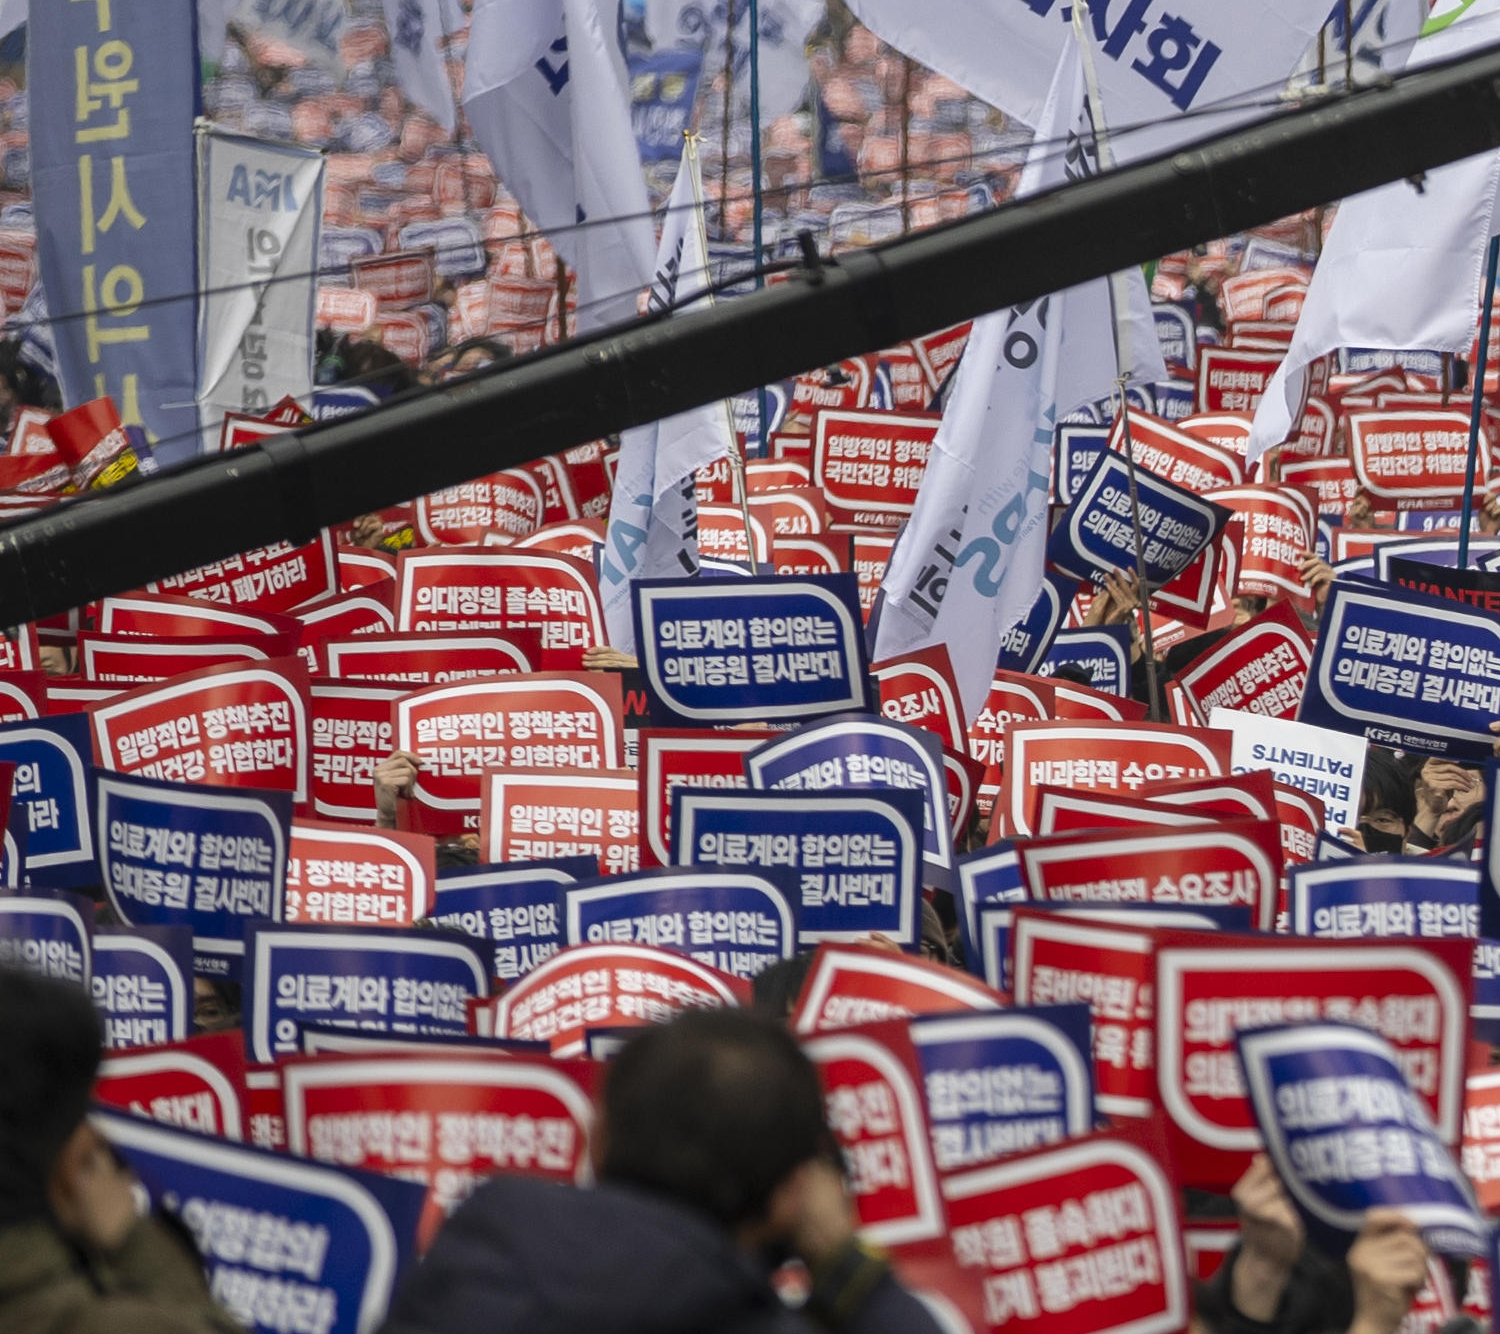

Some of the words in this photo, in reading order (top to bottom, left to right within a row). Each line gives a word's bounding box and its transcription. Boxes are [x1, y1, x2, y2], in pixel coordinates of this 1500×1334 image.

[828, 434, 890, 461] 일방적인
[826, 461, 888, 487] 국민건강
[233, 560, 308, 601] 폐기하라
[414, 585, 498, 616] 의대정원
[504, 584, 586, 615] 졸속확대
[660, 618, 746, 651] 의료계와
[749, 616, 837, 647] 합의없는
[1343, 625, 1426, 662] 의료계와
[664, 654, 749, 685] 의대증원
[753, 650, 842, 682] 결사반대
[1335, 659, 1420, 697] 의대증원
[1423, 676, 1500, 715] 결사반대
[116, 713, 202, 766] 일방적인
[202, 698, 293, 745] 정책추진
[414, 713, 498, 743] 일방적인
[508, 711, 596, 741] 정책추진
[1363, 725, 1402, 748] KMA
[1251, 742, 1355, 782] PATIENTS
[305, 890, 408, 923] 위협한다
[308, 1112, 430, 1167] 일방적인
[436, 1112, 571, 1169] 정책추진
